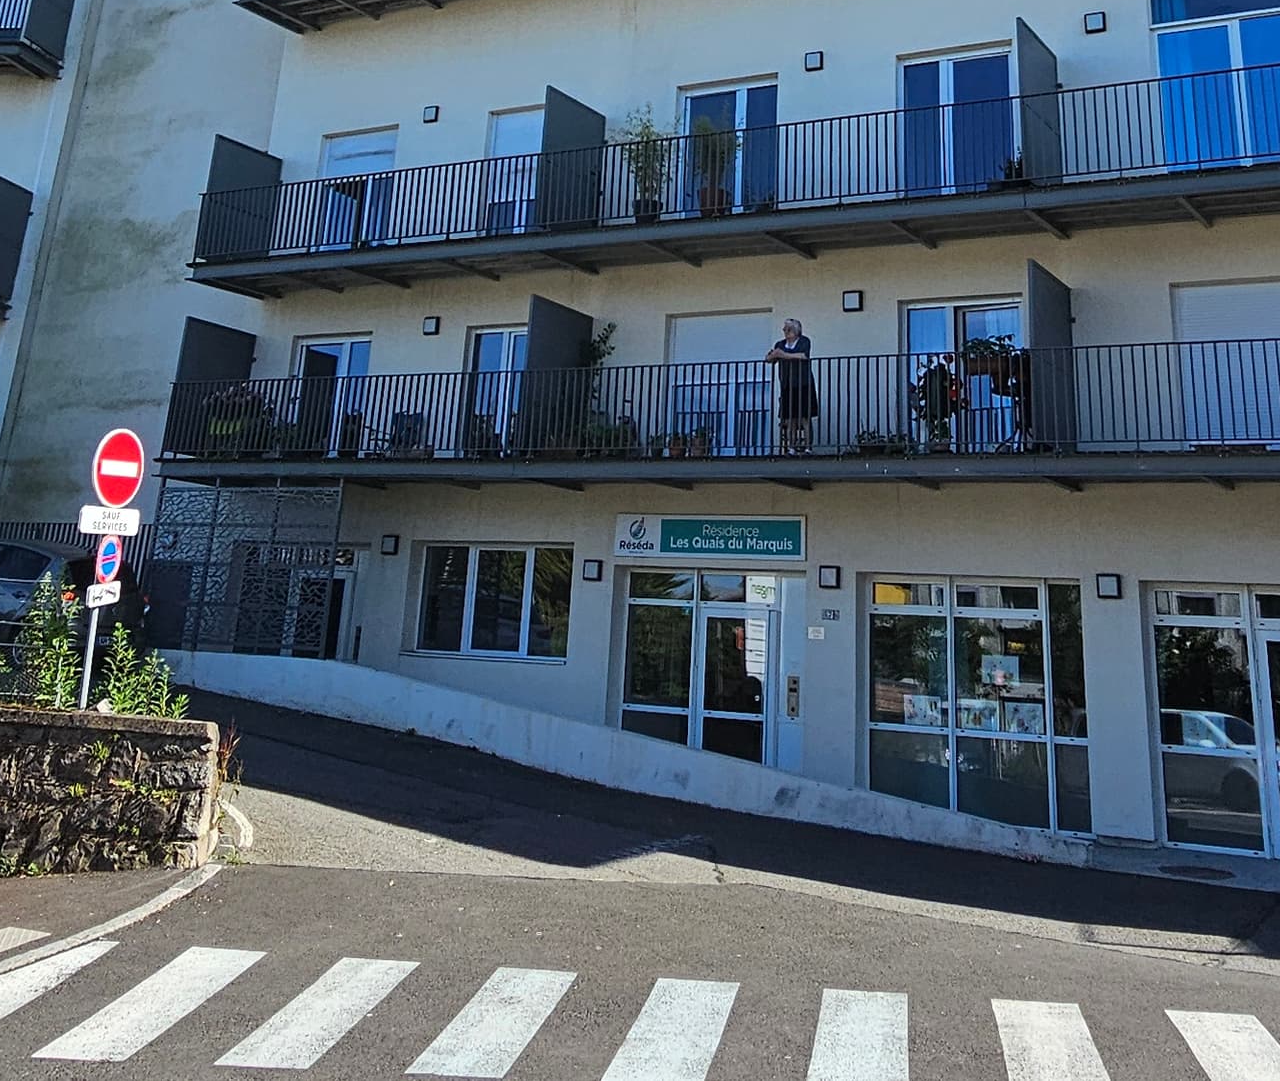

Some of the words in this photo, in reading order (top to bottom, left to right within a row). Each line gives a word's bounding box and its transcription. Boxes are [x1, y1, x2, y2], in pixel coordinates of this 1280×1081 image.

[102, 511, 120, 520] SAUF
[92, 521, 128, 531] SERVICES
[702, 524, 759, 537] Résidence
[619, 538, 654, 551] Réséda
[670, 536, 689, 548] Les
[692, 536, 725, 550] Quais
[728, 537, 743, 550] du
[746, 537, 793, 552] Marquis
